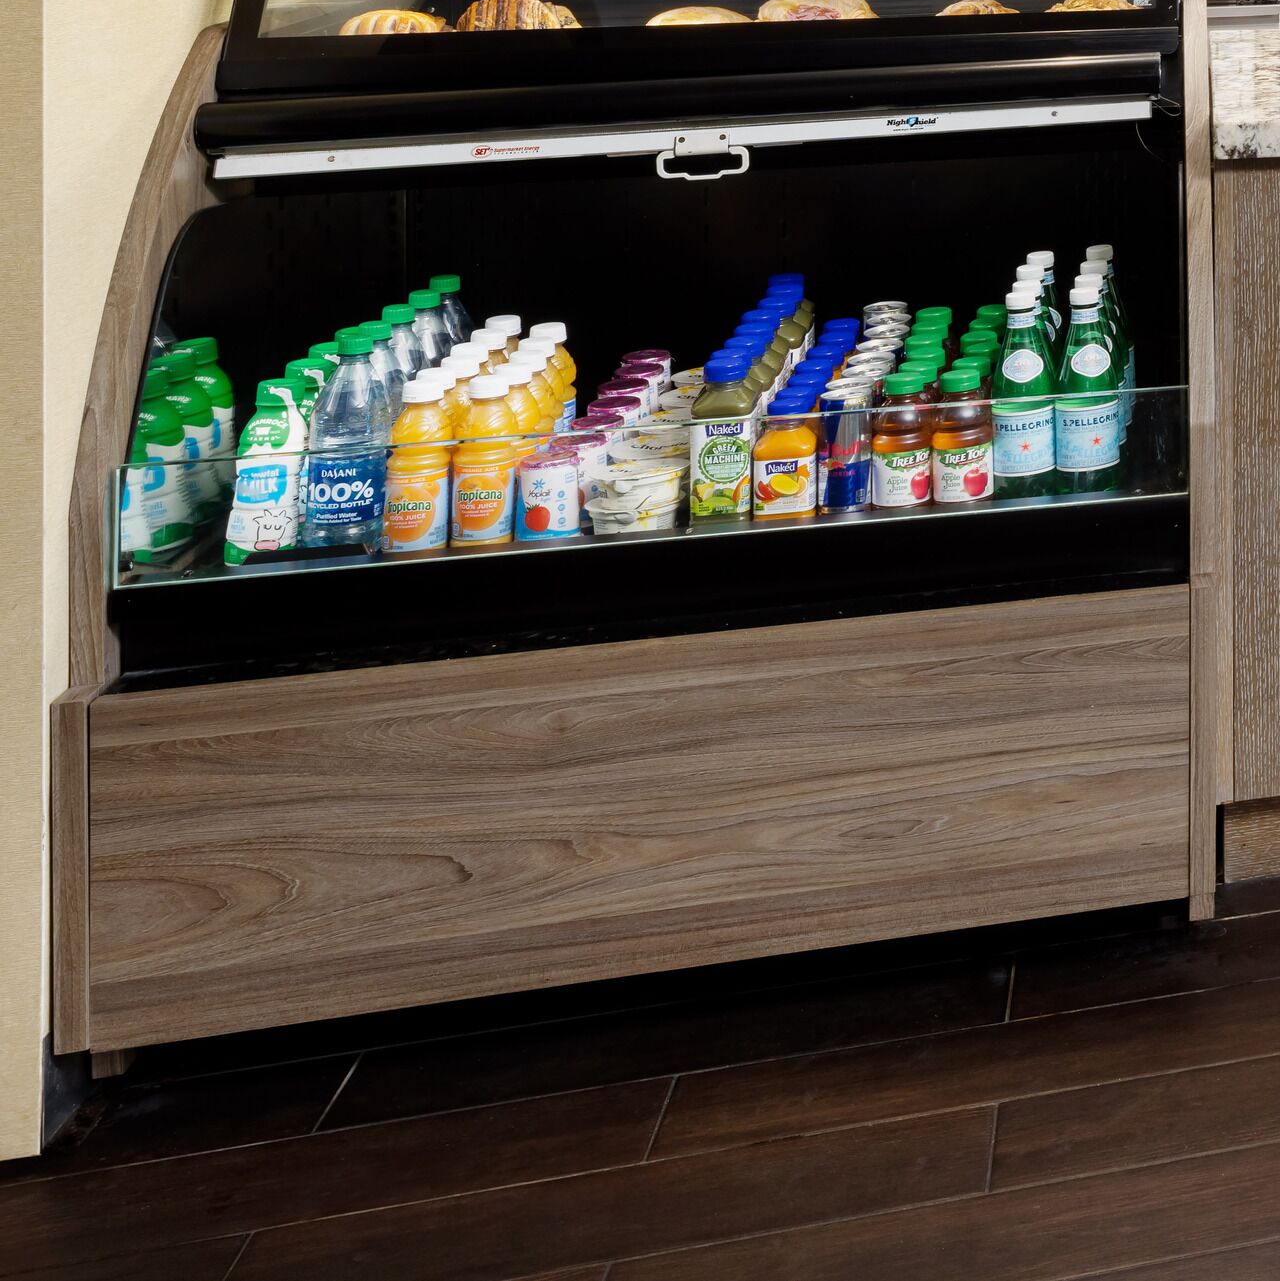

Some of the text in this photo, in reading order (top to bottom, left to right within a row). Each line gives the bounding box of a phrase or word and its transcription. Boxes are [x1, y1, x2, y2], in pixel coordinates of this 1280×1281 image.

[475, 148, 487, 156] SET
[708, 423, 741, 436] Naked
[712, 443, 737, 455] GREEN
[705, 453, 745, 464] MACHINE
[768, 462, 796, 473] Naked
[321, 468, 357, 479] DASANI
[308, 478, 374, 503] 100%
[457, 489, 503, 502] Tropicana
[387, 500, 432, 514] Tropicana
[476, 501, 498, 510] JUICE
